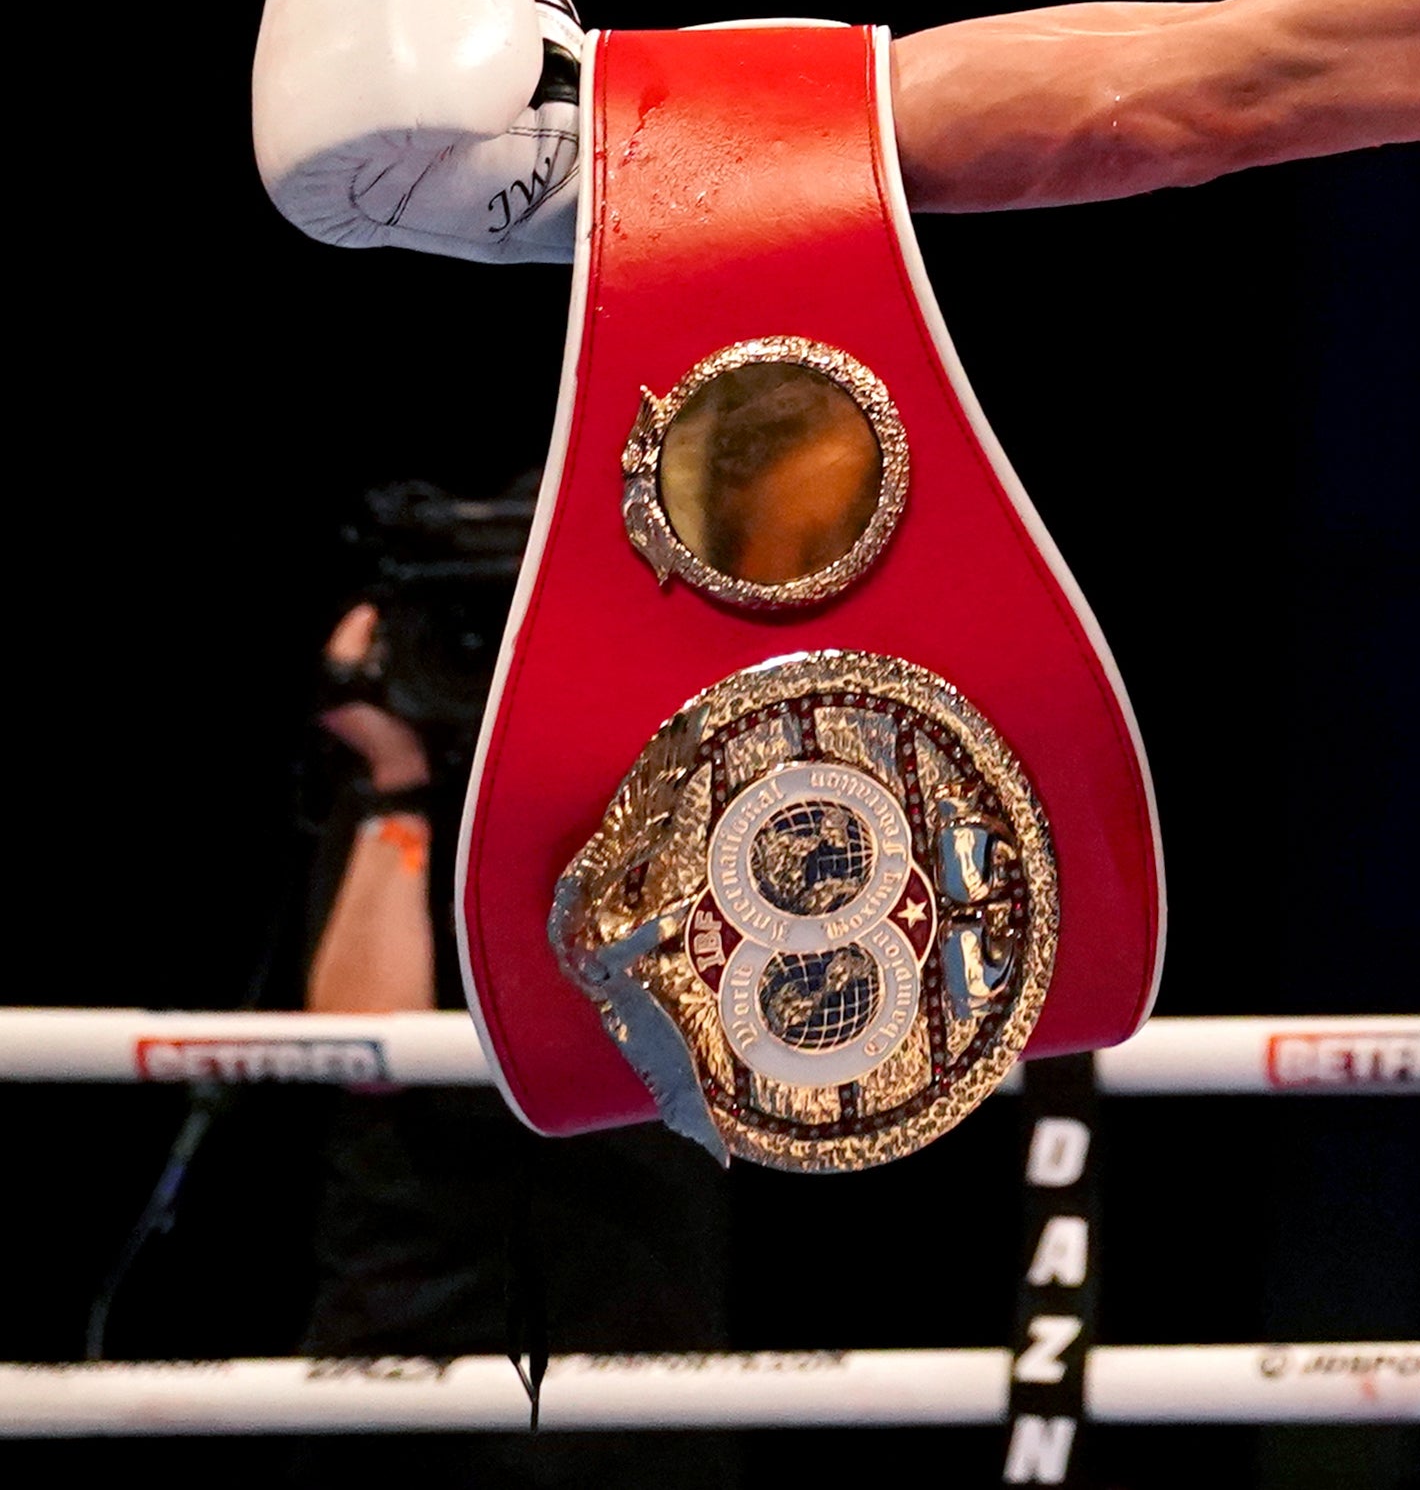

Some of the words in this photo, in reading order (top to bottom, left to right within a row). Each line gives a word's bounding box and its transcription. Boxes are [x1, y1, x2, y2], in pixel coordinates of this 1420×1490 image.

[718, 777, 788, 943] International
[809, 769, 909, 863] Federation
[697, 910, 726, 974] IBF
[824, 869, 904, 940] Boxing
[732, 961, 758, 1051] World
[863, 929, 917, 1057] Champion
[1003, 1116, 1091, 1485] DAZN
